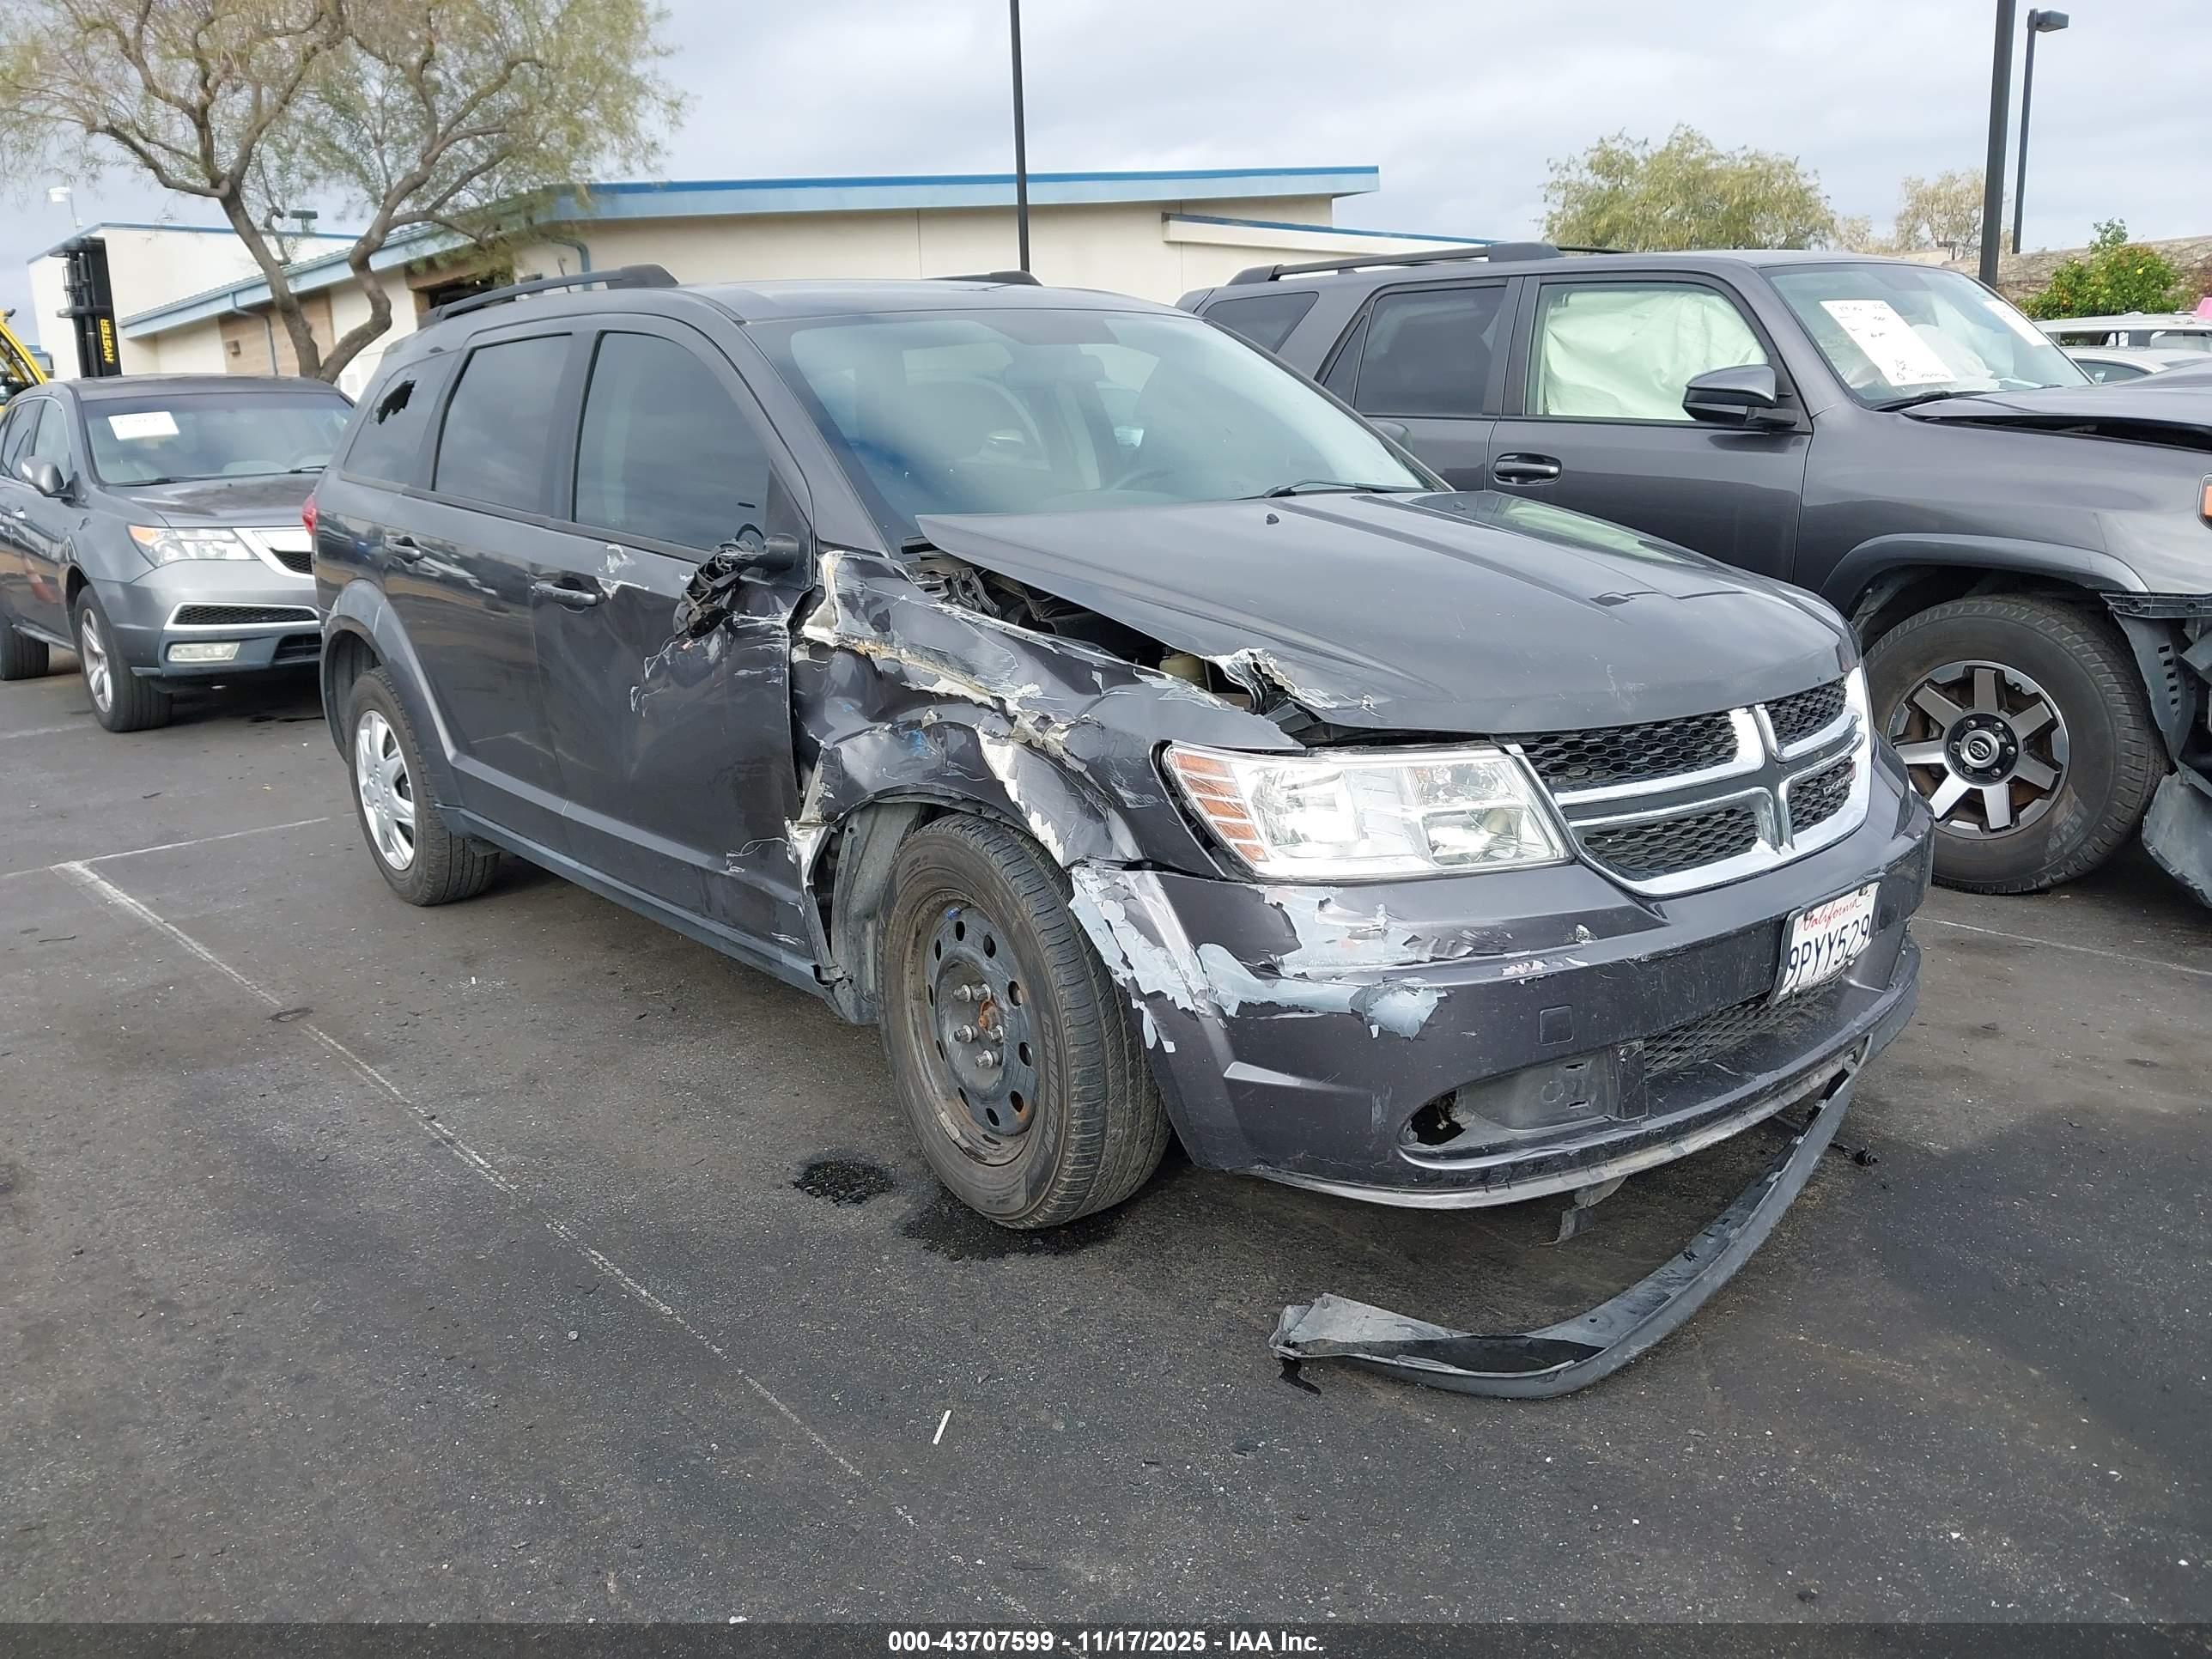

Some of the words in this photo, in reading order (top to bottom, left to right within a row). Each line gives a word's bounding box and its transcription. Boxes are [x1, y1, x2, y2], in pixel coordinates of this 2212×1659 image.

[100, 318, 114, 364] HYSTER
[1798, 897, 1863, 933] California
[1784, 914, 1870, 988] 9PYY529
